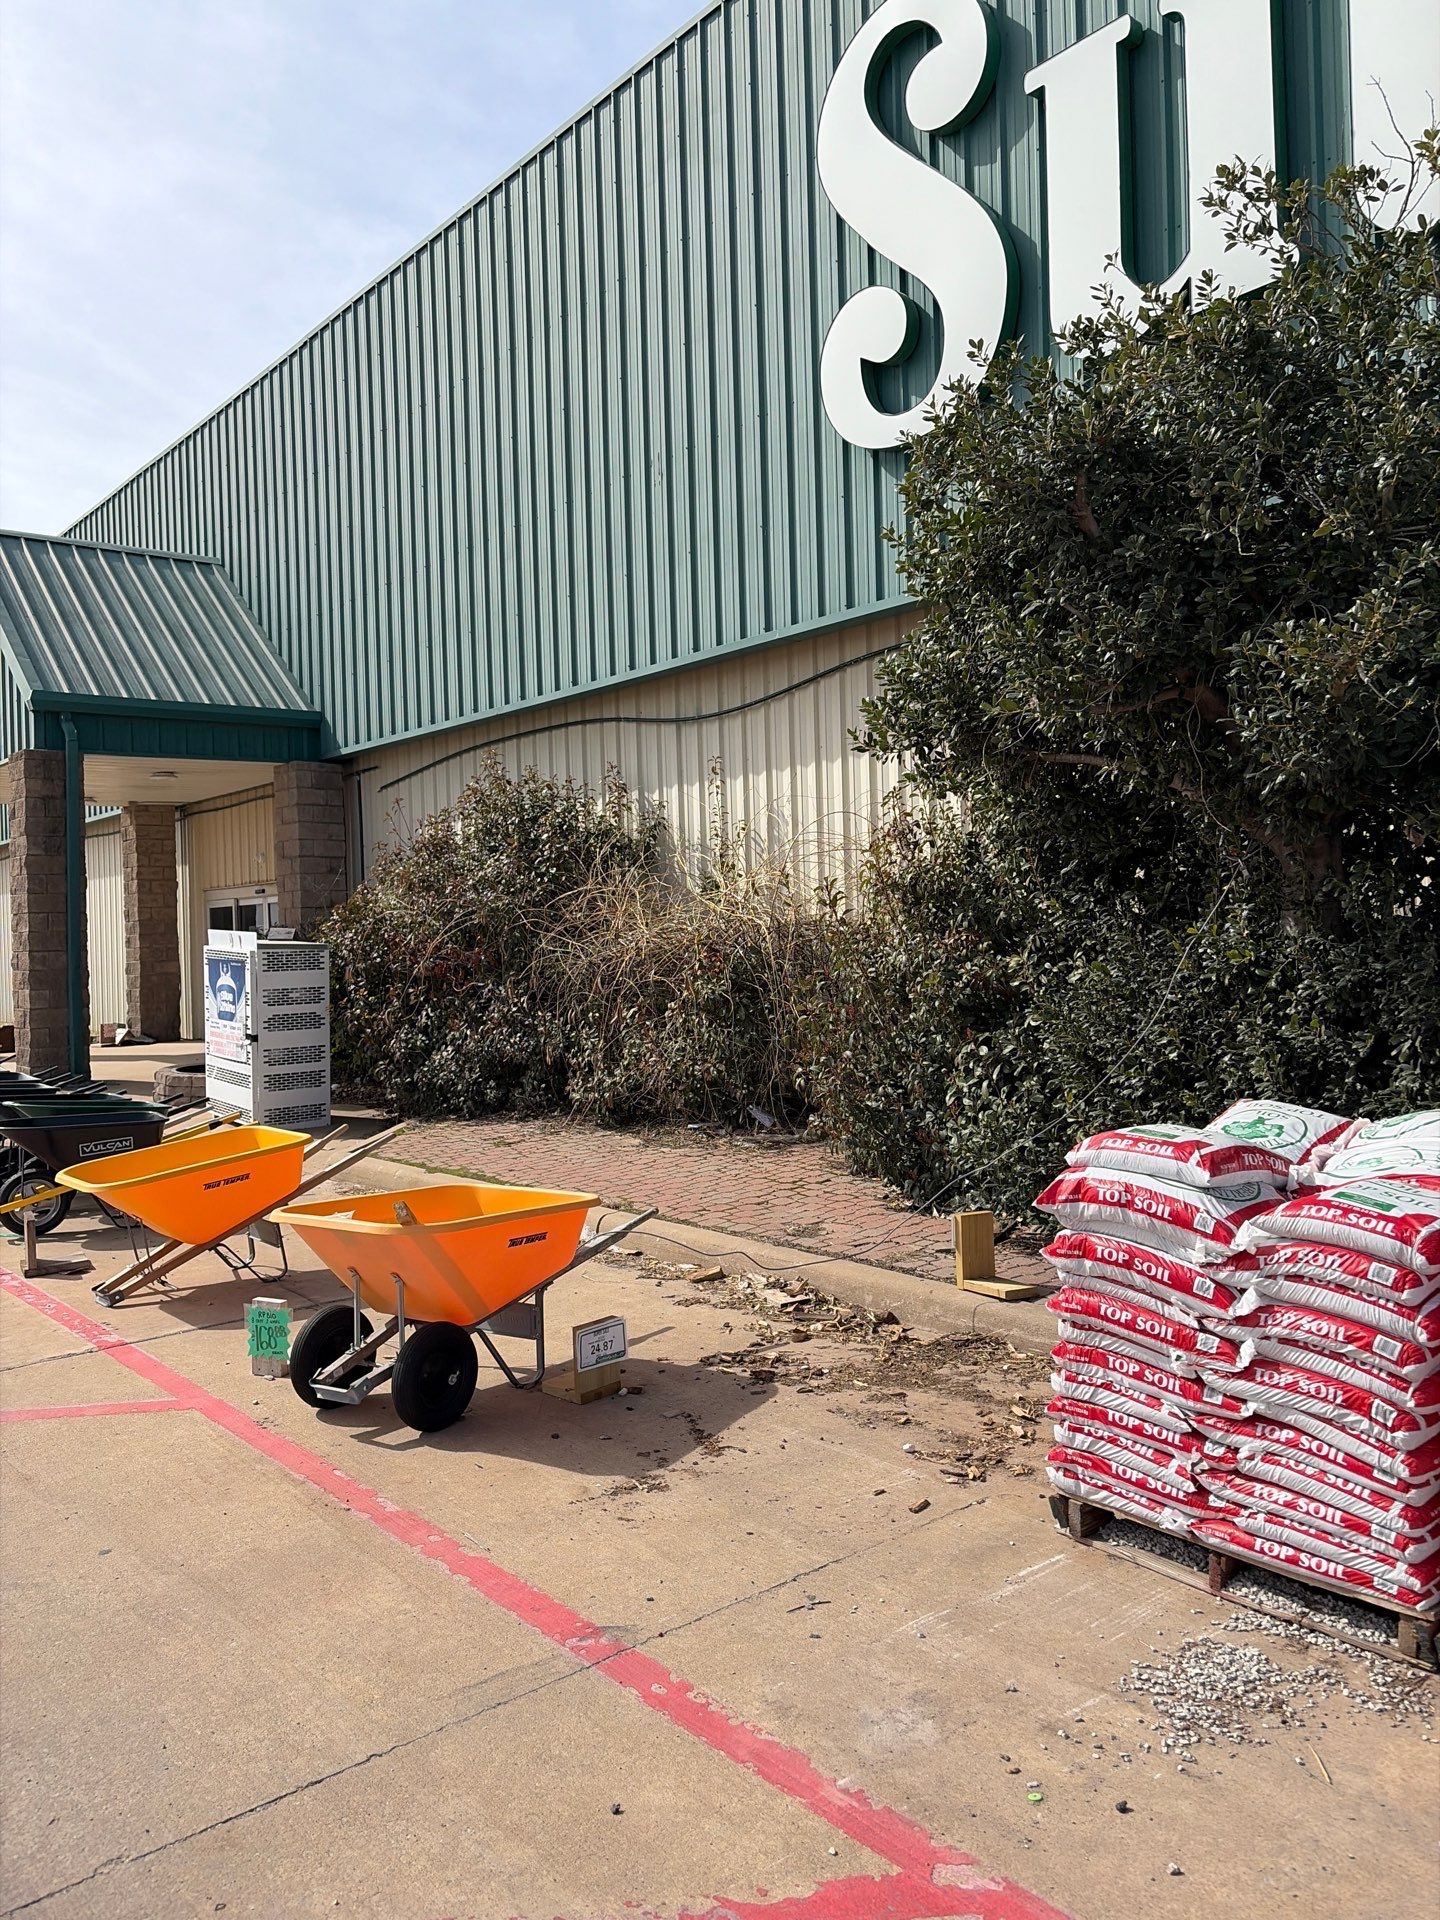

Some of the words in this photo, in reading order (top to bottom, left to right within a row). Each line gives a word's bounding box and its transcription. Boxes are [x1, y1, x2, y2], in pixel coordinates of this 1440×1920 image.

[817, 0, 1440, 450] Su
[83, 1139, 130, 1152] VULCAN
[1100, 1138, 1134, 1149] TOP
[1136, 1141, 1176, 1156] SOIL
[1242, 1153, 1266, 1167] TOP
[1267, 1157, 1288, 1172] SOIL
[1097, 1187, 1131, 1204] TOP
[1133, 1196, 1173, 1220] SOIL
[1301, 1205, 1342, 1219] TOP
[1345, 1212, 1397, 1236] SOIL
[1095, 1244, 1130, 1263] TOP
[1133, 1257, 1173, 1284] SOIL
[1256, 1250, 1291, 1268] TOP
[1297, 1247, 1345, 1270] SOIL
[1099, 1303, 1133, 1323] TOP
[1135, 1316, 1176, 1341] SOIL
[1257, 1312, 1297, 1327] TOP
[1299, 1315, 1348, 1343] SOIL
[590, 1339, 614, 1355] 24.87
[1106, 1354, 1140, 1376] TOP
[1143, 1368, 1183, 1394] SOIL
[1254, 1367, 1294, 1387] TOP
[1297, 1378, 1346, 1405] SOIL
[1107, 1408, 1140, 1429] TOP
[1143, 1422, 1184, 1446] SOIL
[1254, 1422, 1296, 1442] TOP
[1299, 1435, 1348, 1466] SOIL
[1109, 1461, 1144, 1482] TOP
[1146, 1476, 1188, 1502] SOIL
[1324, 1473, 1373, 1502] SOIL
[1253, 1483, 1295, 1502] TOP
[1296, 1499, 1346, 1527] SOIL
[1253, 1537, 1295, 1560] TOP
[1298, 1552, 1348, 1580] SOIL
